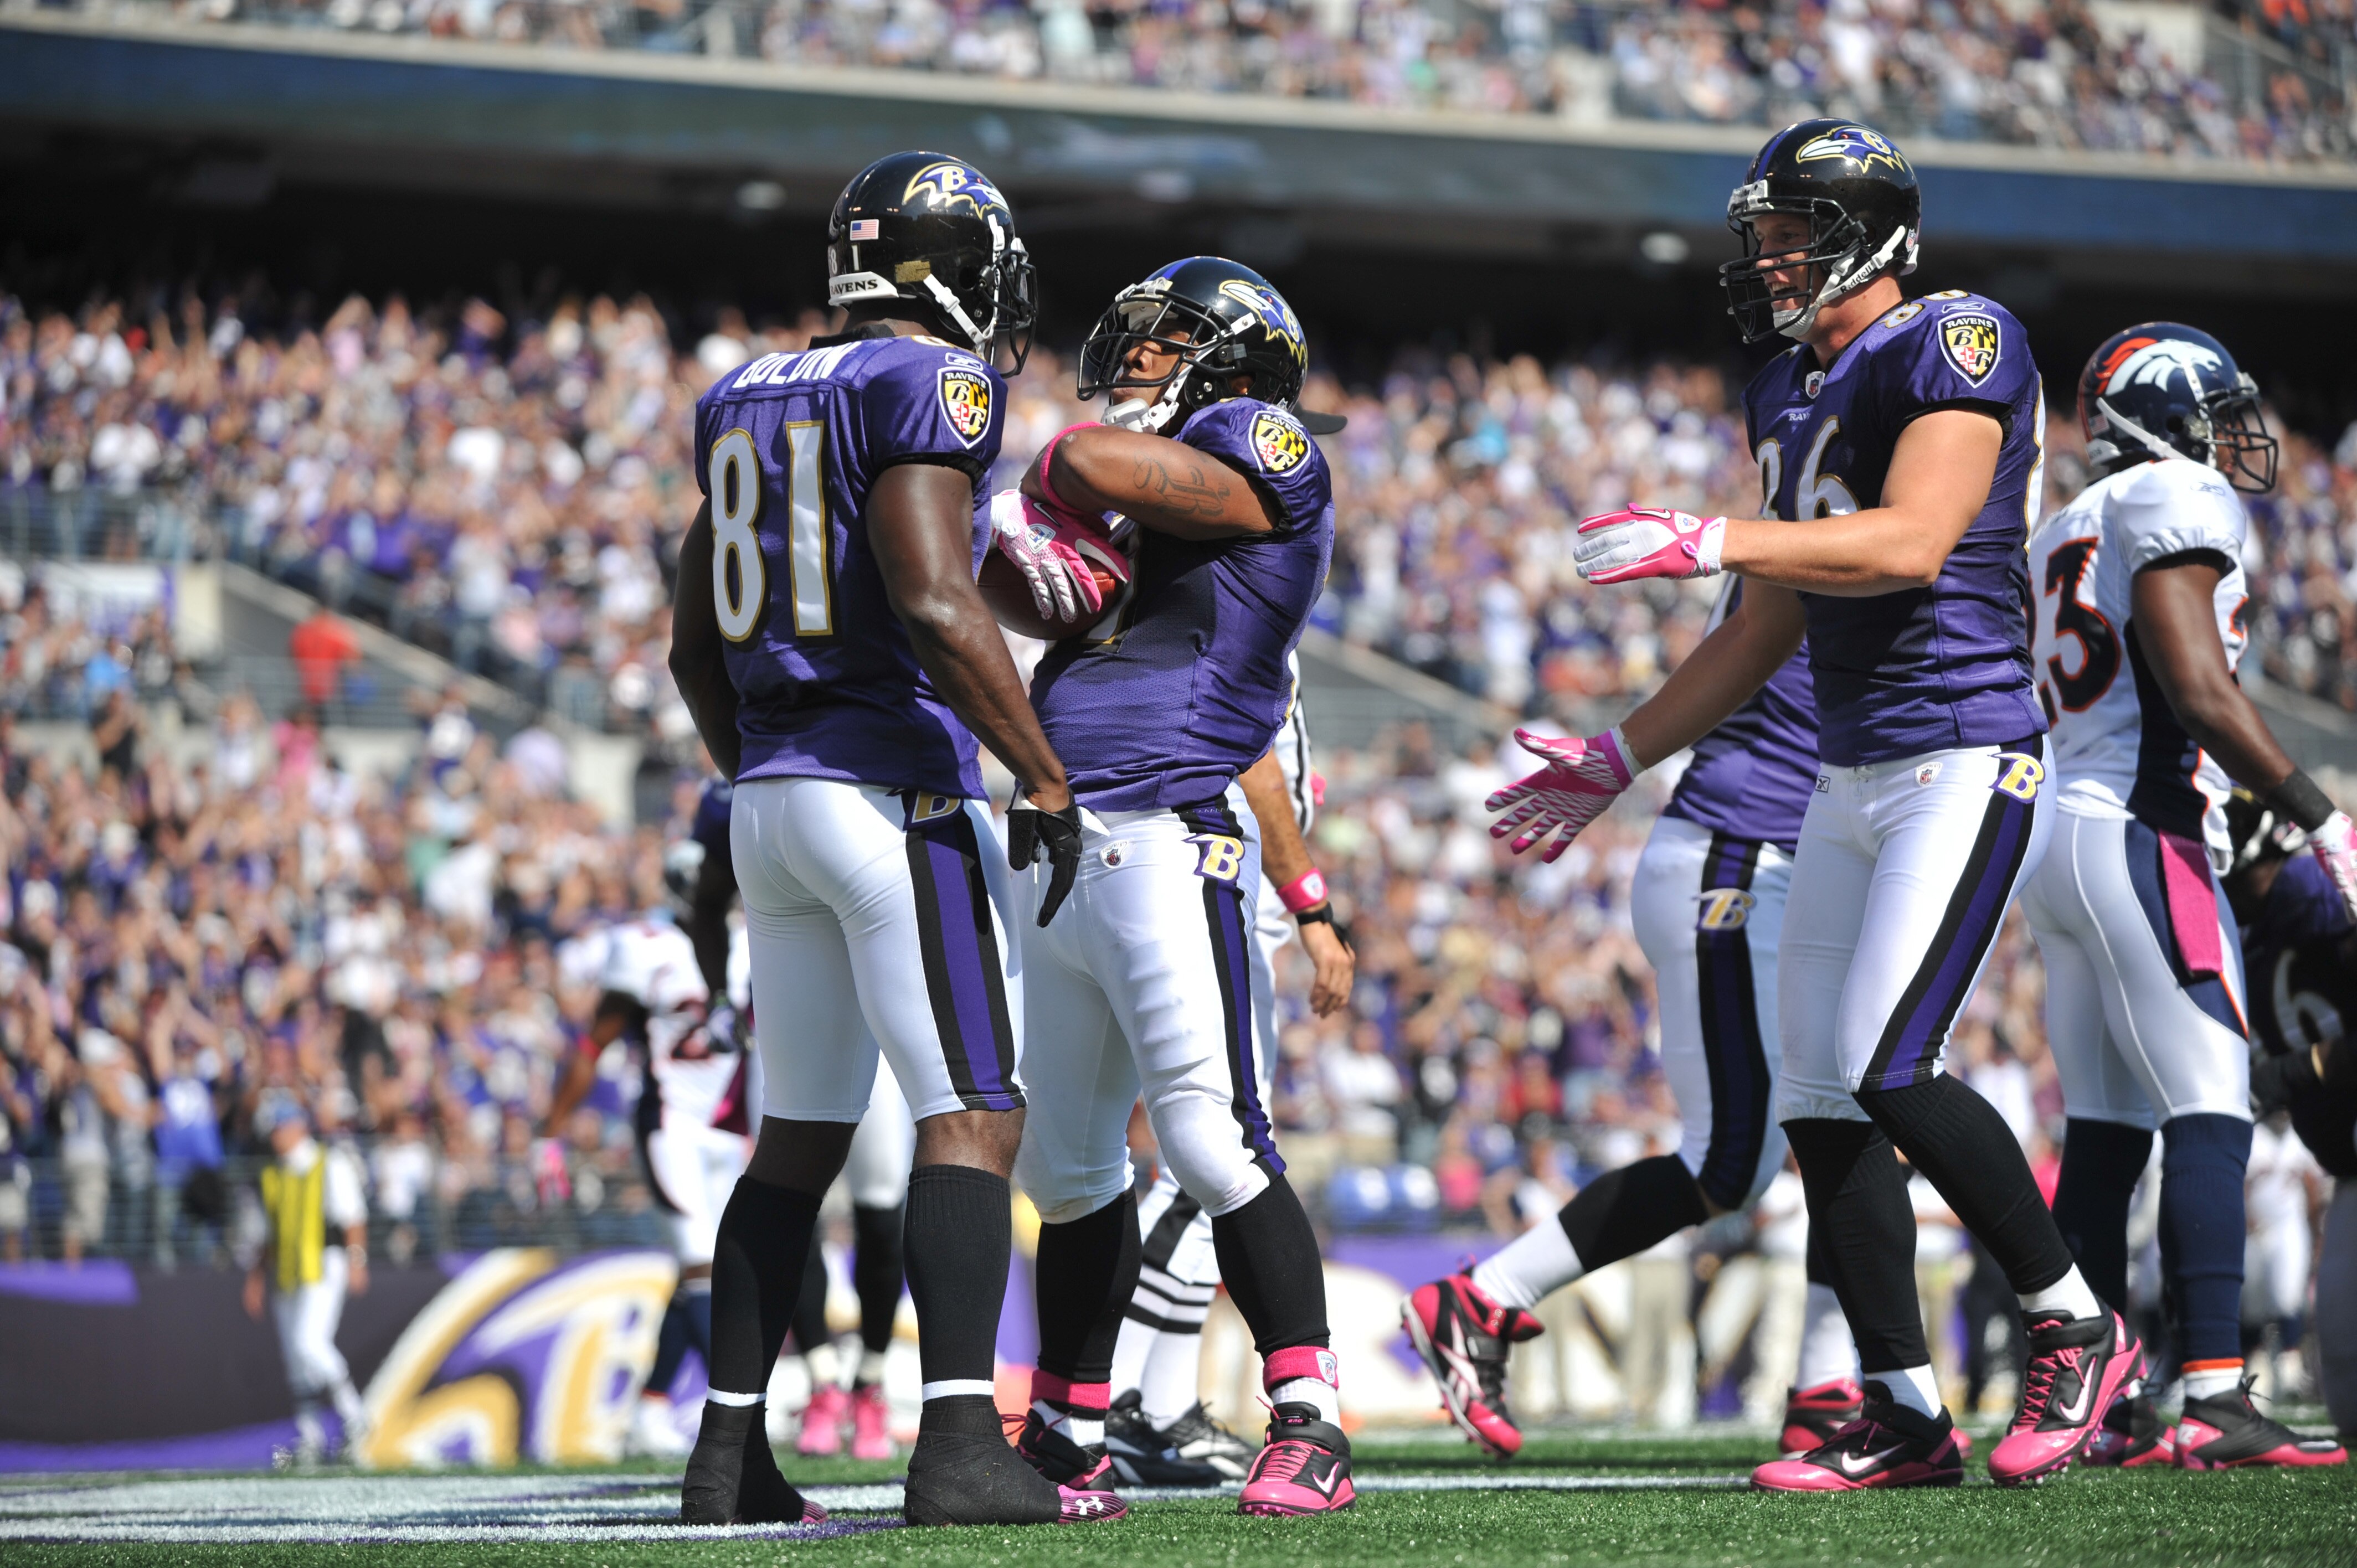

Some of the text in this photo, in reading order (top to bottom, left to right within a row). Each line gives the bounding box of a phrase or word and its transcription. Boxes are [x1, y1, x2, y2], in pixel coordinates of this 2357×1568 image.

[1862, 131, 1892, 154] B
[941, 167, 968, 192] B
[831, 279, 878, 295] RAVENS
[1946, 317, 1993, 328] RAVENS
[1952, 328, 1973, 346] B
[732, 341, 862, 388] BOLDIN
[945, 372, 986, 389] RAVENS
[952, 383, 969, 403] B
[1260, 424, 1284, 442] B
[1262, 414, 1305, 442] RAVENS
[709, 420, 833, 642] 81
[1990, 751, 2045, 801] B
[1187, 833, 1244, 881] B
[1698, 888, 1754, 930] B
